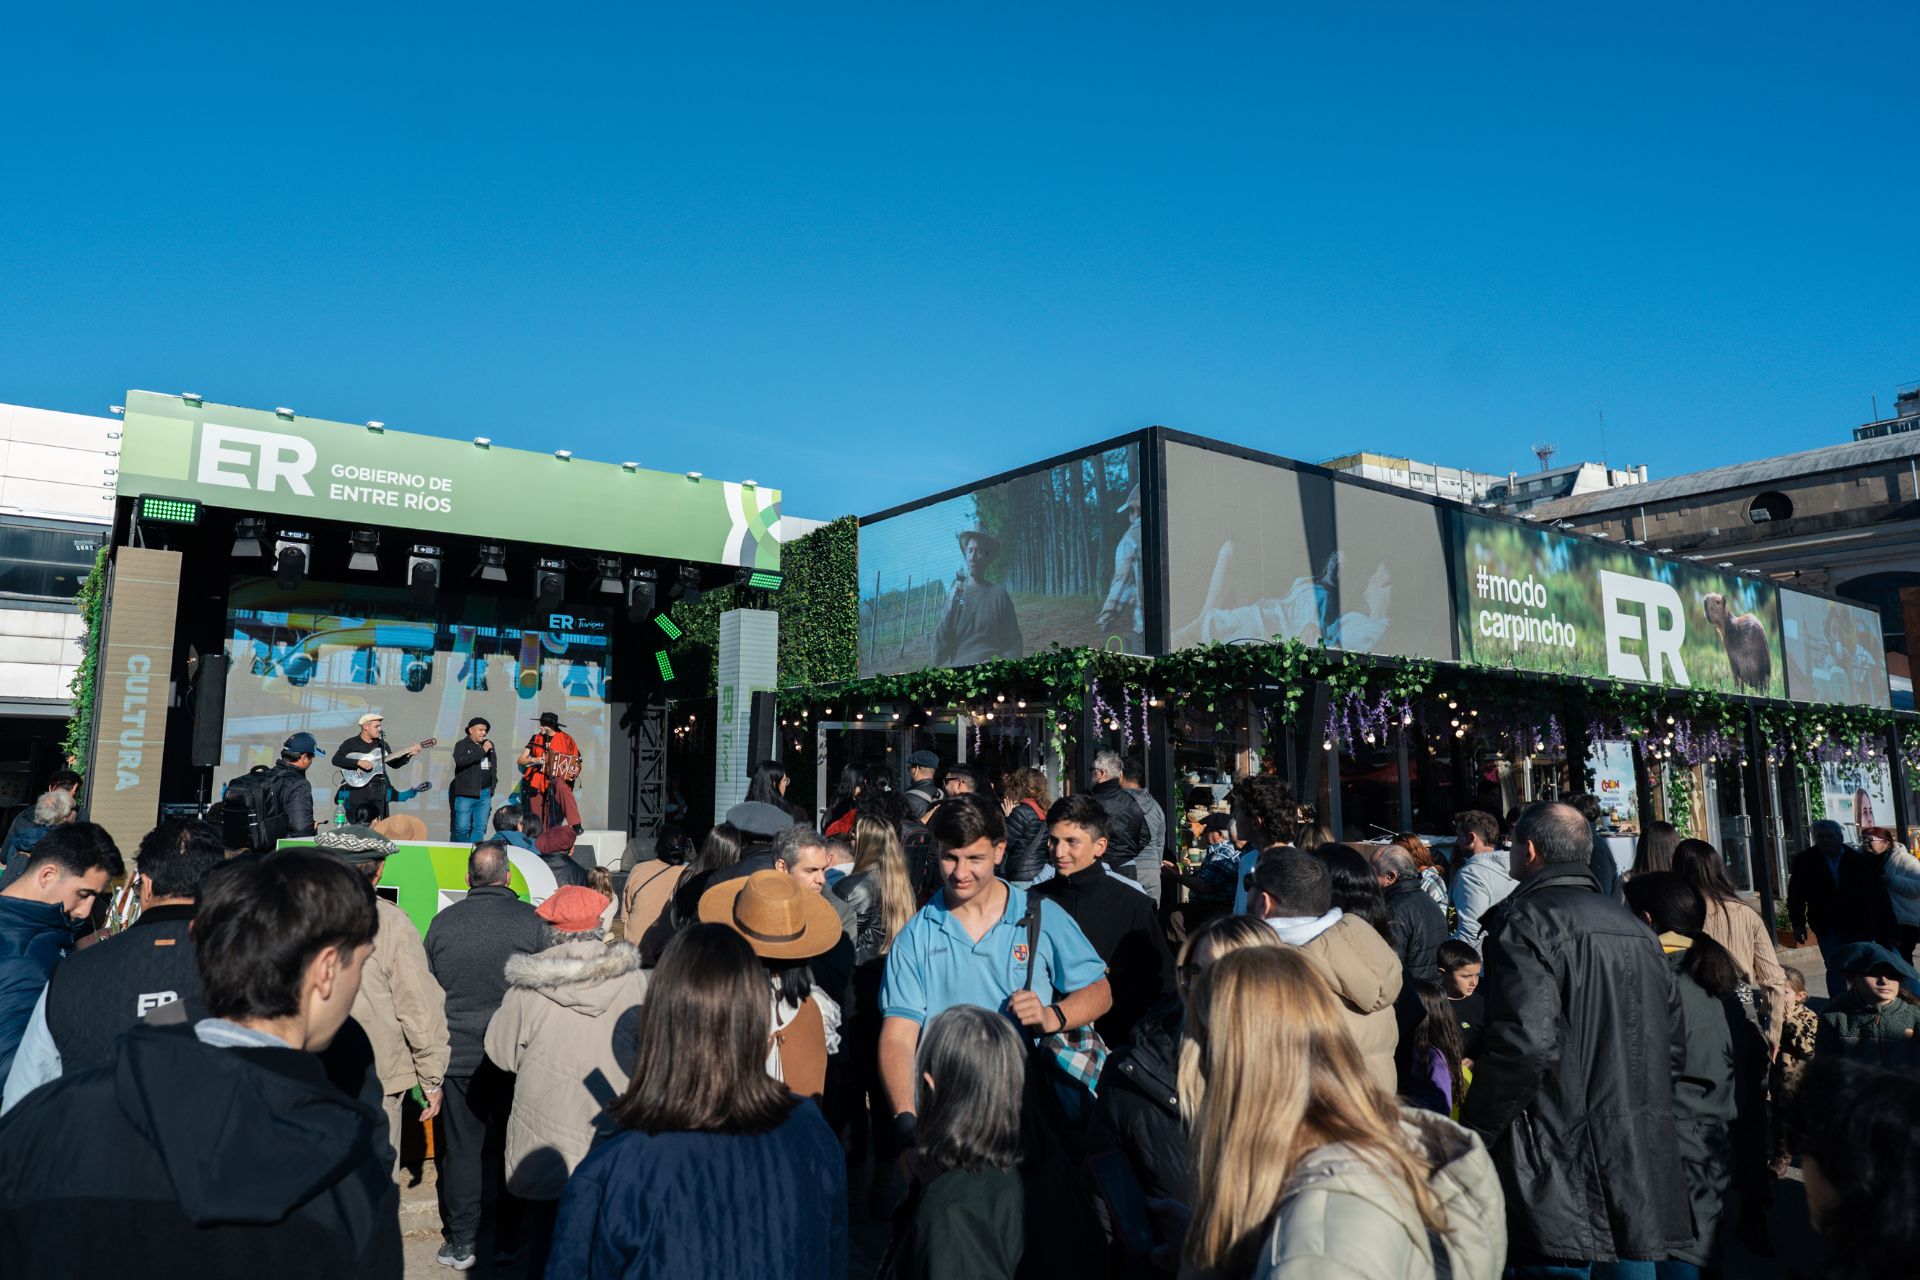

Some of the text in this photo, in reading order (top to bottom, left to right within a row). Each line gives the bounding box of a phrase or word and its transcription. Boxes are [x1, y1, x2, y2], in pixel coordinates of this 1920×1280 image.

[197, 422, 317, 497] ER
[331, 464, 453, 492] GOBIERNO DE
[329, 483, 452, 513] ENTRE RÍOS
[1476, 565, 1547, 609] #modo
[549, 614, 574, 630] ER
[1479, 608, 1576, 651] carpincho
[1600, 569, 1691, 686] ER
[115, 655, 151, 792] CULTURA
[723, 685, 734, 724] ER
